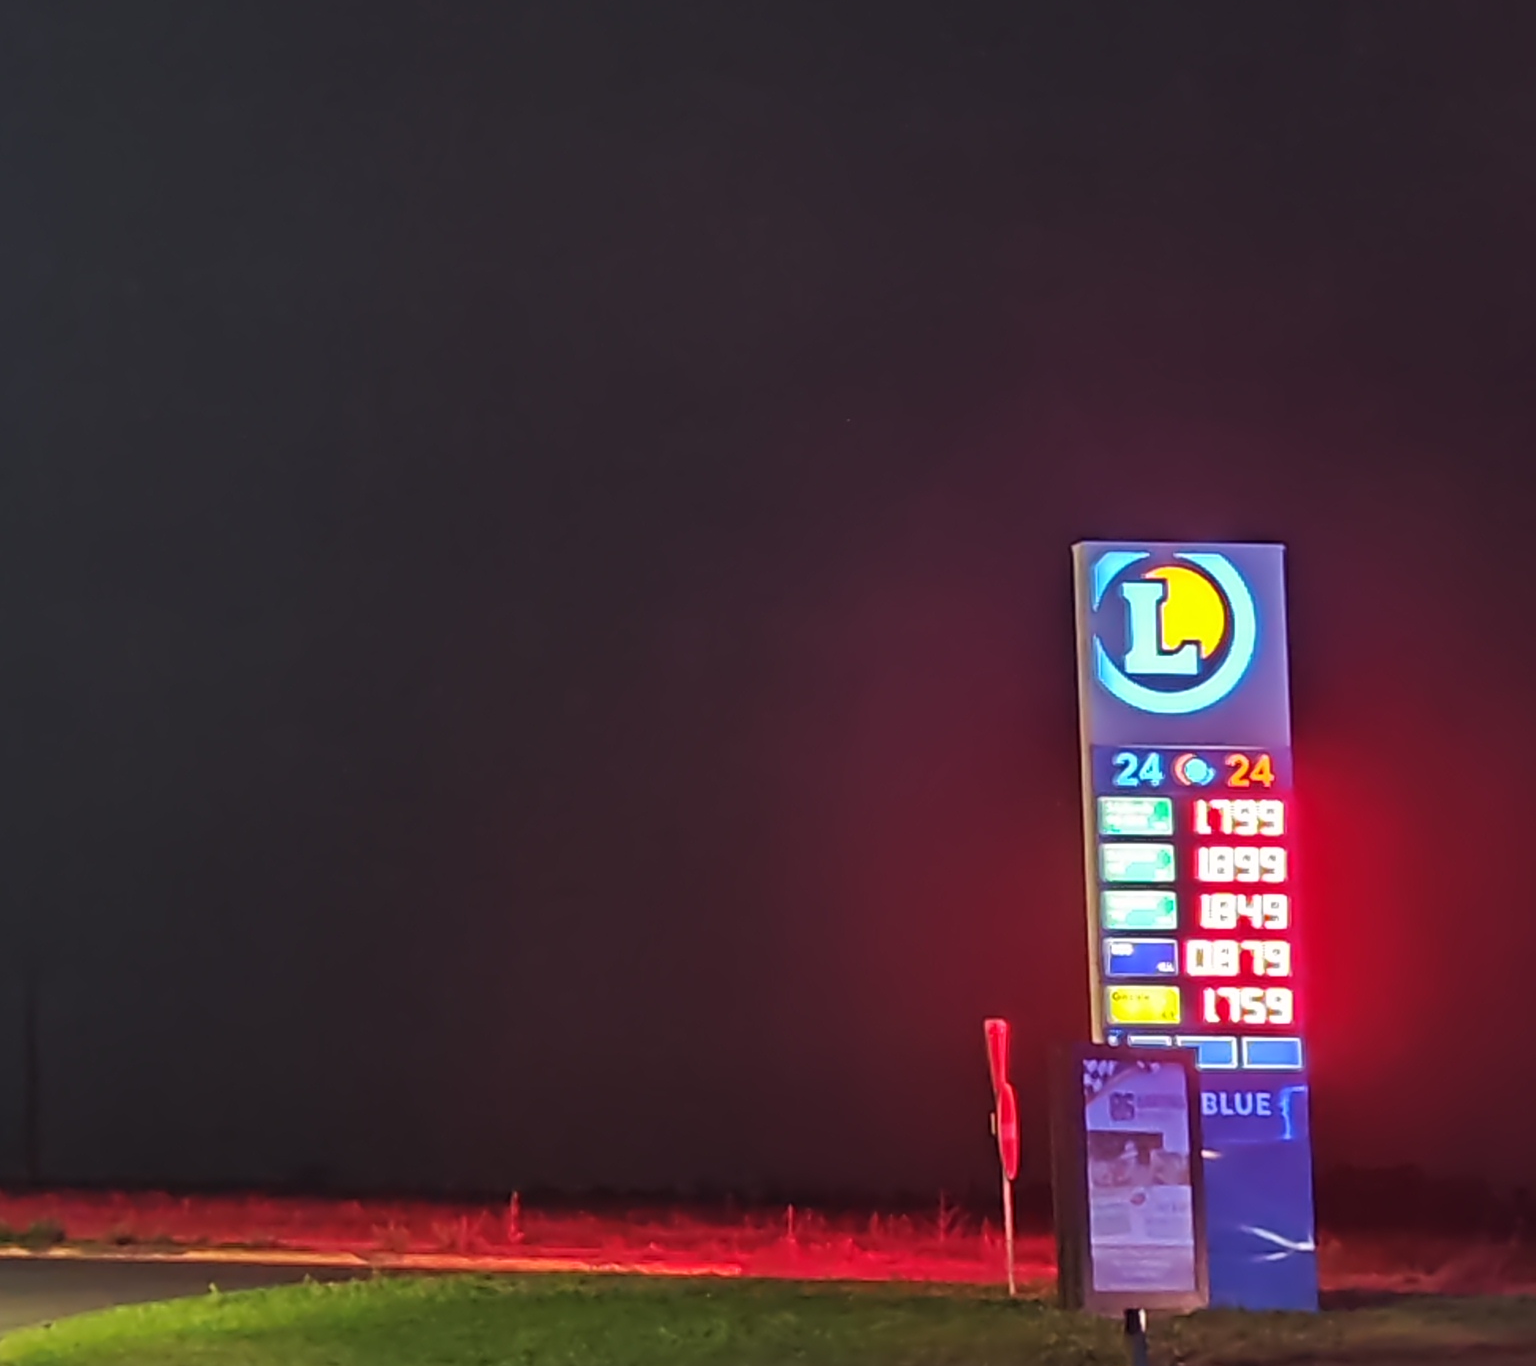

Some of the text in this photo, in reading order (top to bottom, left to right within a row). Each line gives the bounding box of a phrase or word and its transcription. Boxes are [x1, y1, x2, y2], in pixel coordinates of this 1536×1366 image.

[1121, 582, 1199, 675] L
[1113, 752, 1275, 788] 24 24
[1194, 799, 1284, 835] 1799
[1203, 987, 1293, 1024] 1759
